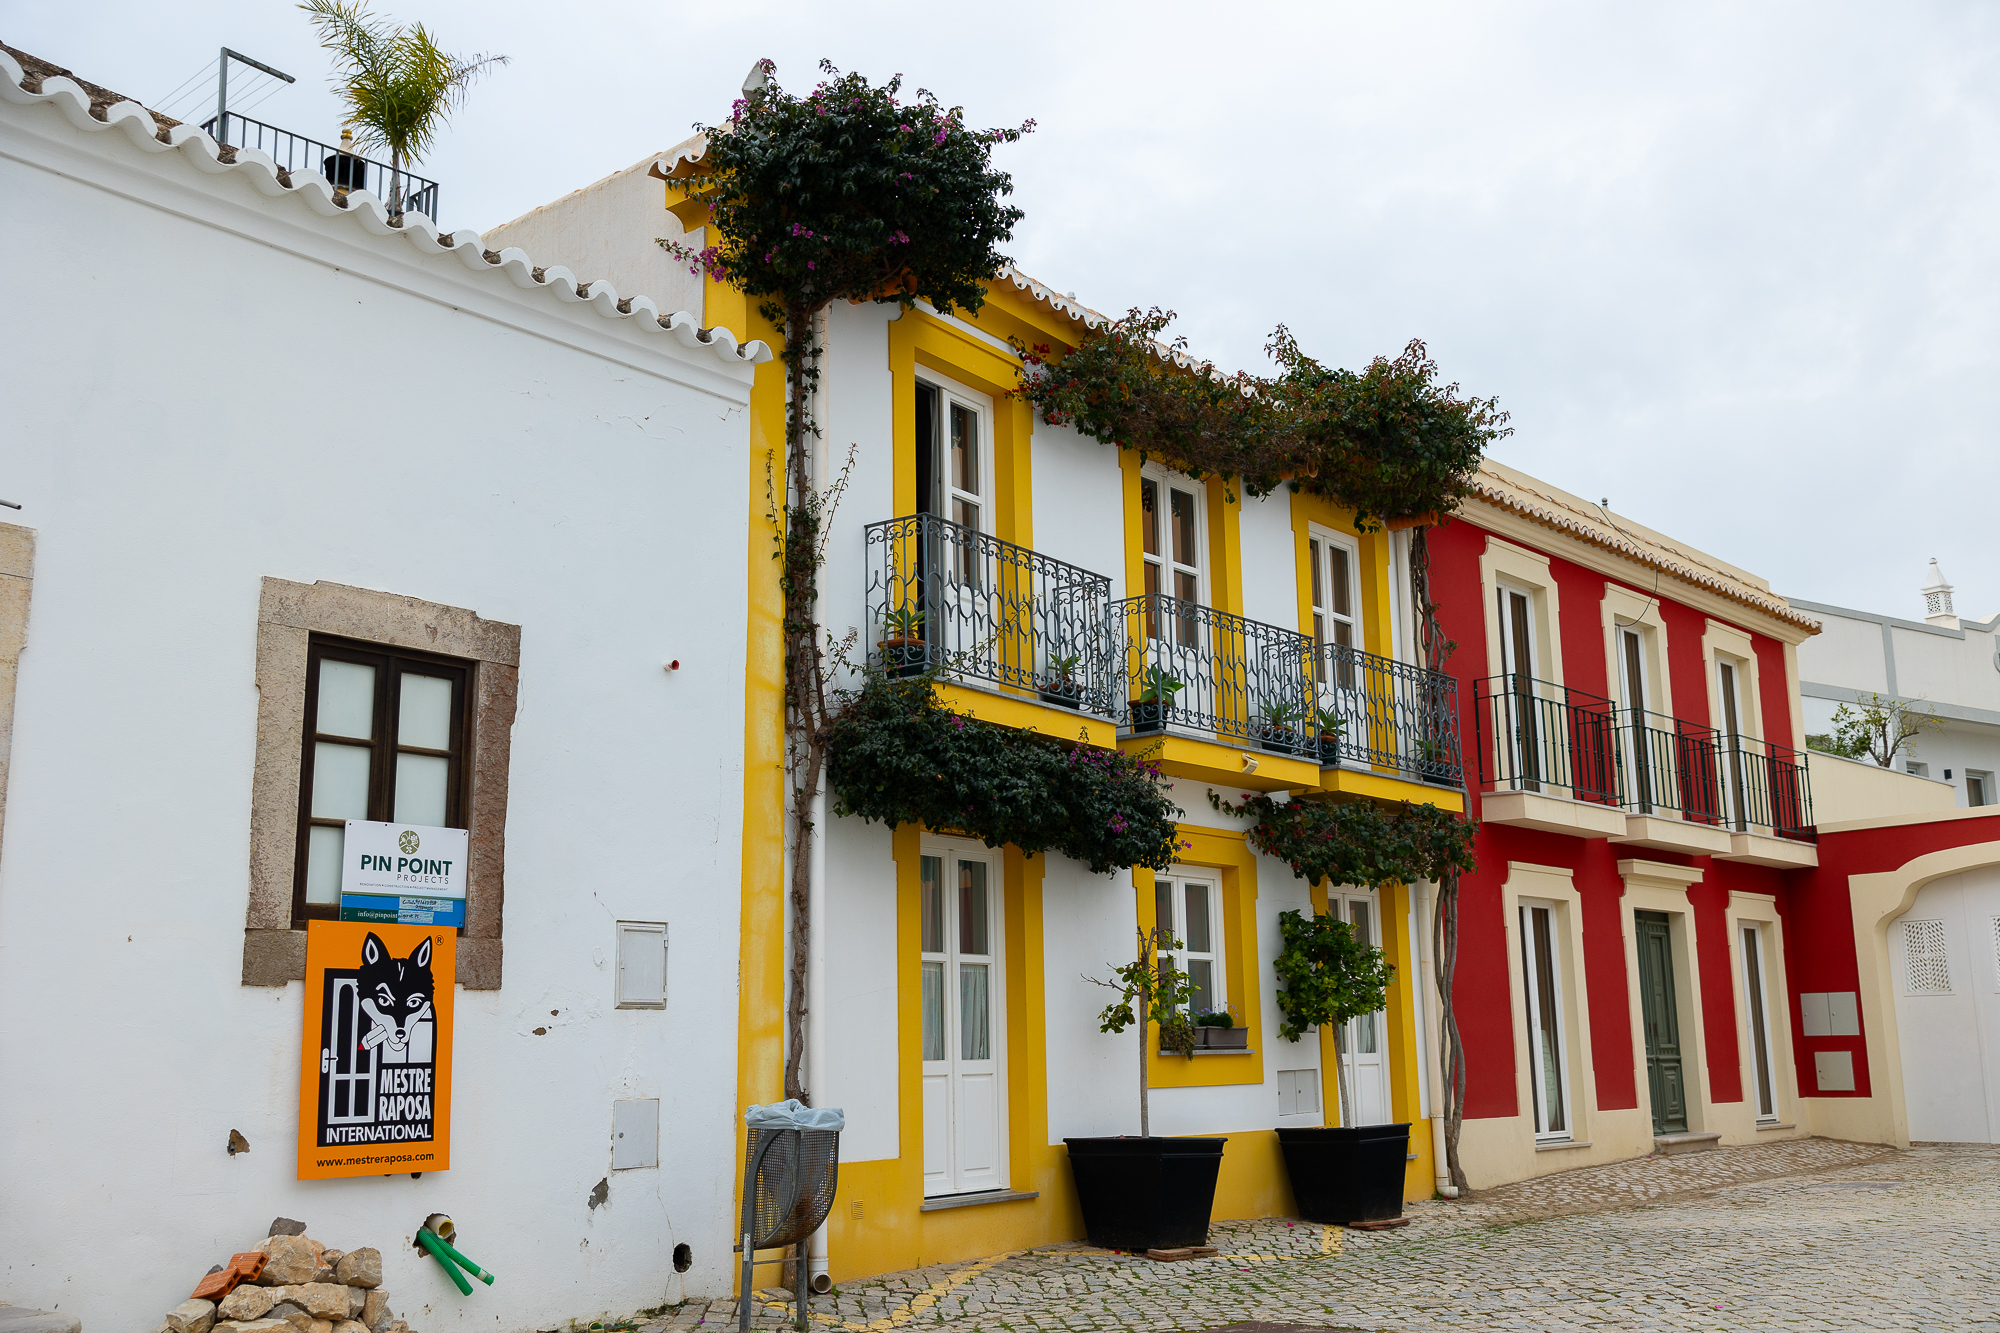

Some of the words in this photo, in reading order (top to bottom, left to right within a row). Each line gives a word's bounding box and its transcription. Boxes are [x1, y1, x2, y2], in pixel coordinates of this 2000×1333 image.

[360, 854, 392, 872] PIN
[397, 857, 453, 876] POINT
[397, 874, 449, 884] PROJECTS
[379, 1068, 431, 1094] MESTRE
[378, 1095, 432, 1122] RAPOSA
[326, 1124, 432, 1144] INTERNATIONAL
[316, 1152, 435, 1168] www.mestreraposa.com
